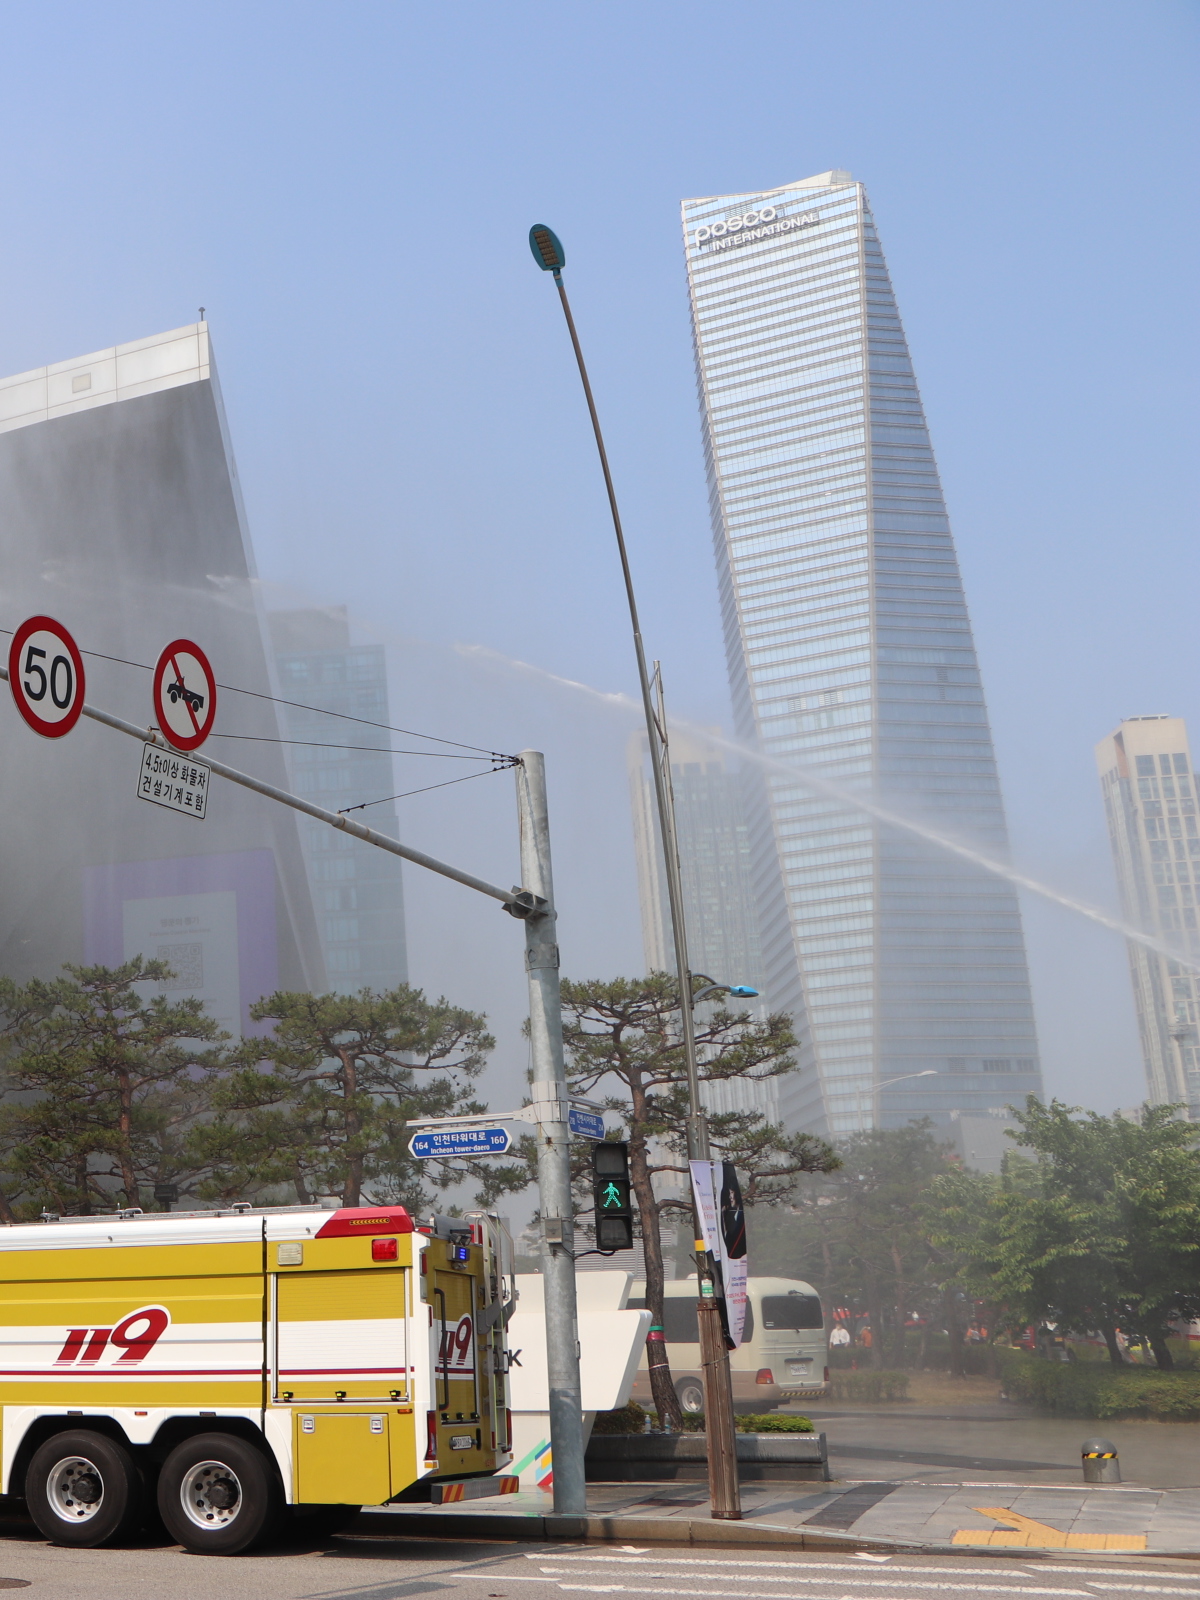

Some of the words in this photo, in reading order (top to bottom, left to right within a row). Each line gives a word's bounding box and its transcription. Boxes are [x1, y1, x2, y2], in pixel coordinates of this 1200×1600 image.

[712, 213, 819, 251] INTERNATIONAL
[23, 645, 73, 710] 50
[145, 752, 179, 780] 4.5t이상
[180, 765, 206, 789] 화물차
[415, 1142, 429, 1150] 164
[430, 1147, 453, 1155] Incheon
[432, 1132, 487, 1146] 인천타워대로
[490, 1136, 505, 1144] 160
[52, 1308, 169, 1366] 119
